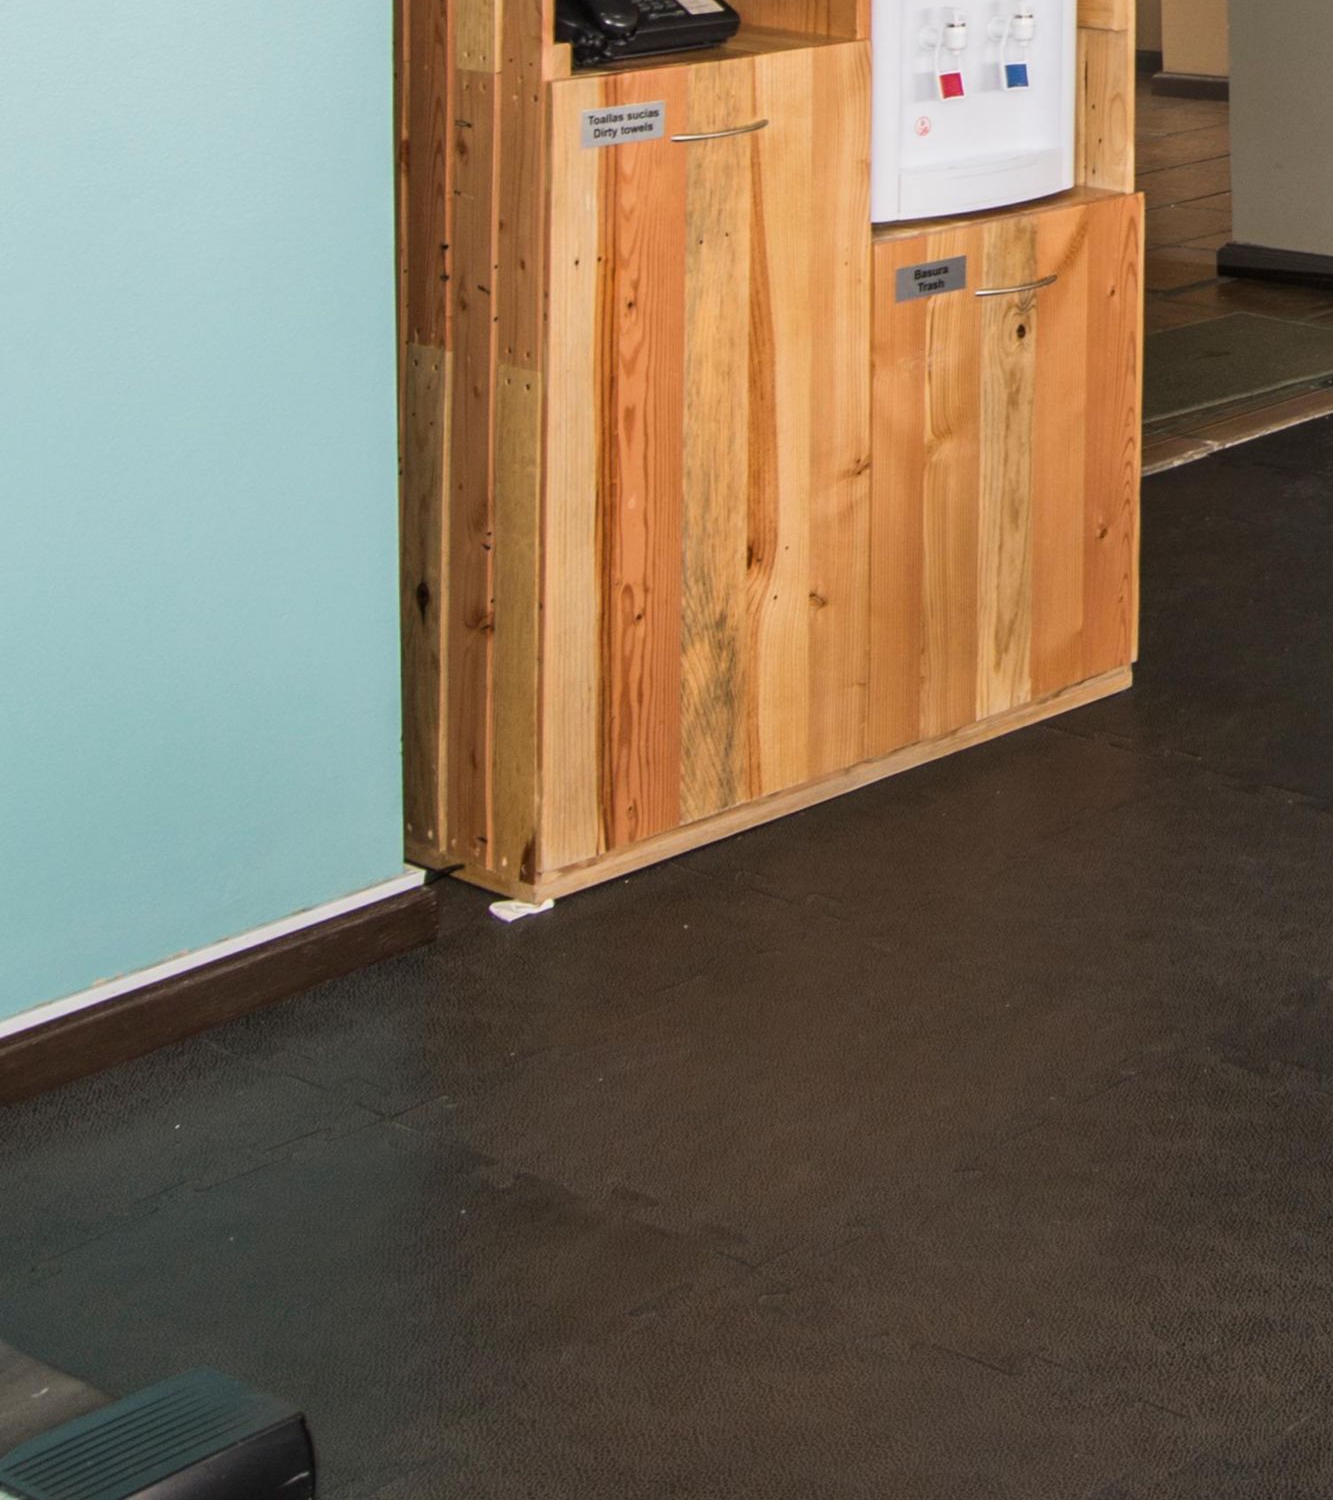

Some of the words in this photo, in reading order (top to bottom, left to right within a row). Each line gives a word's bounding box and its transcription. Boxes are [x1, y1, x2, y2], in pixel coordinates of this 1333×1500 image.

[588, 113, 624, 125] Toallas
[627, 108, 659, 121] sucias
[593, 127, 618, 139] Dirty
[620, 123, 653, 135] towels
[914, 266, 949, 280] Basura
[918, 279, 945, 293] Trash
